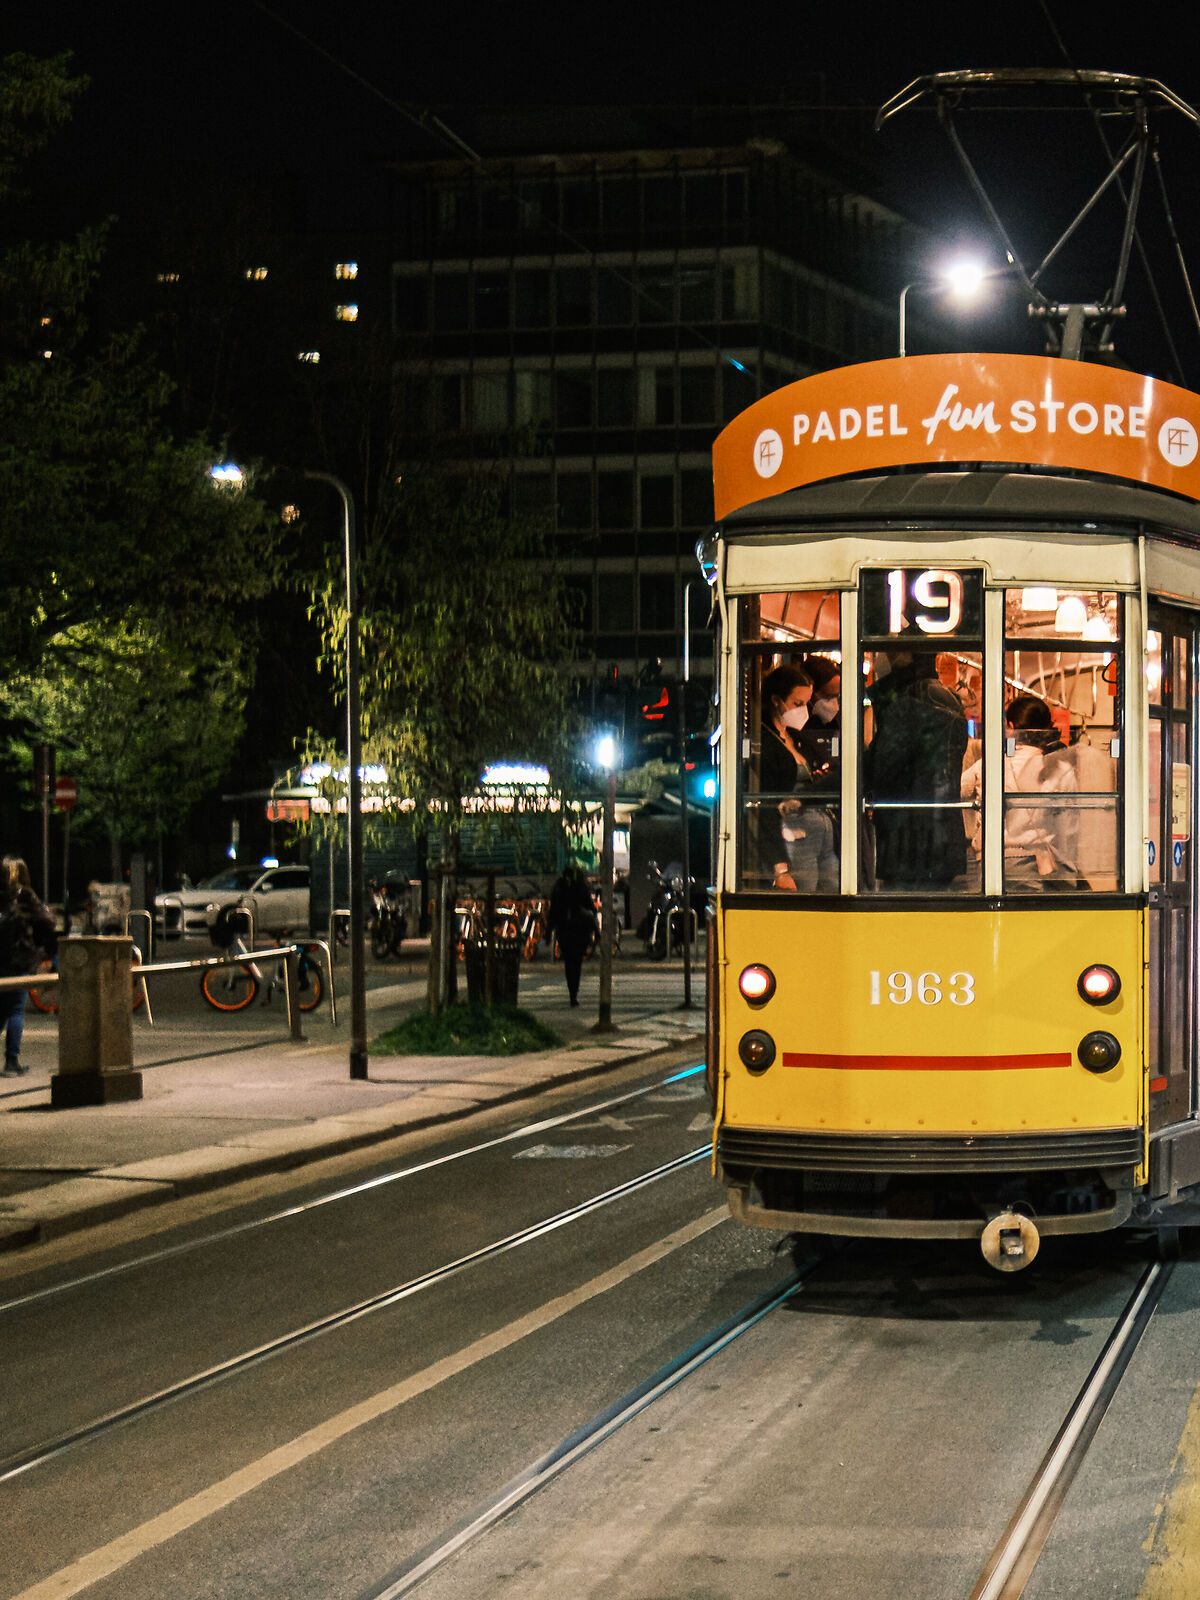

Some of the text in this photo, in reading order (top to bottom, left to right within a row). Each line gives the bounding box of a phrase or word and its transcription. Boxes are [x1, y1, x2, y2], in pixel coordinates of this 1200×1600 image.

[793, 383, 1147, 446] PADEL fun STORE
[887, 569, 965, 636] 19
[869, 970, 976, 1006] 1963
